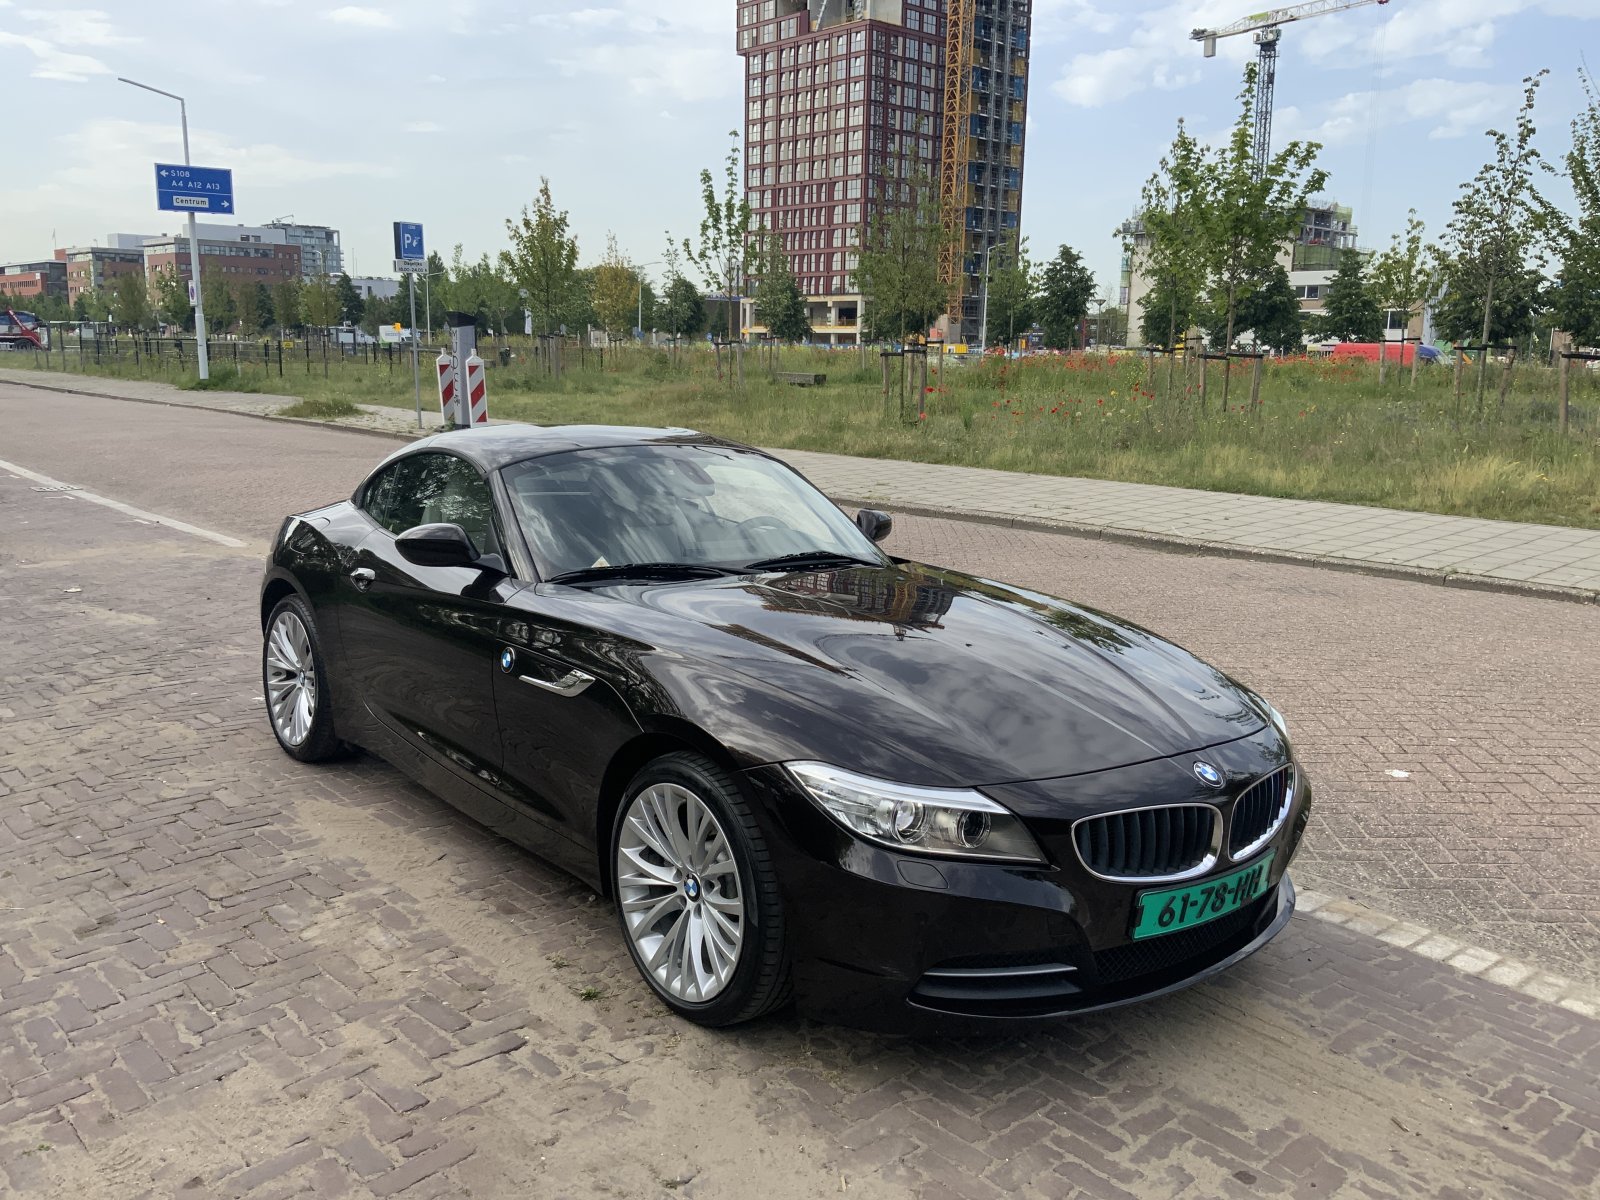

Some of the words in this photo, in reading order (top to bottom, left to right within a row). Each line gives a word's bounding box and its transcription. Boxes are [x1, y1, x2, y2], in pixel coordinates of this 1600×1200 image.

[170, 169, 190, 178] S108
[187, 181, 202, 189] A12
[206, 182, 220, 190] A13
[175, 197, 207, 206] Centrum
[1157, 863, 1264, 928] 61-78-HH
